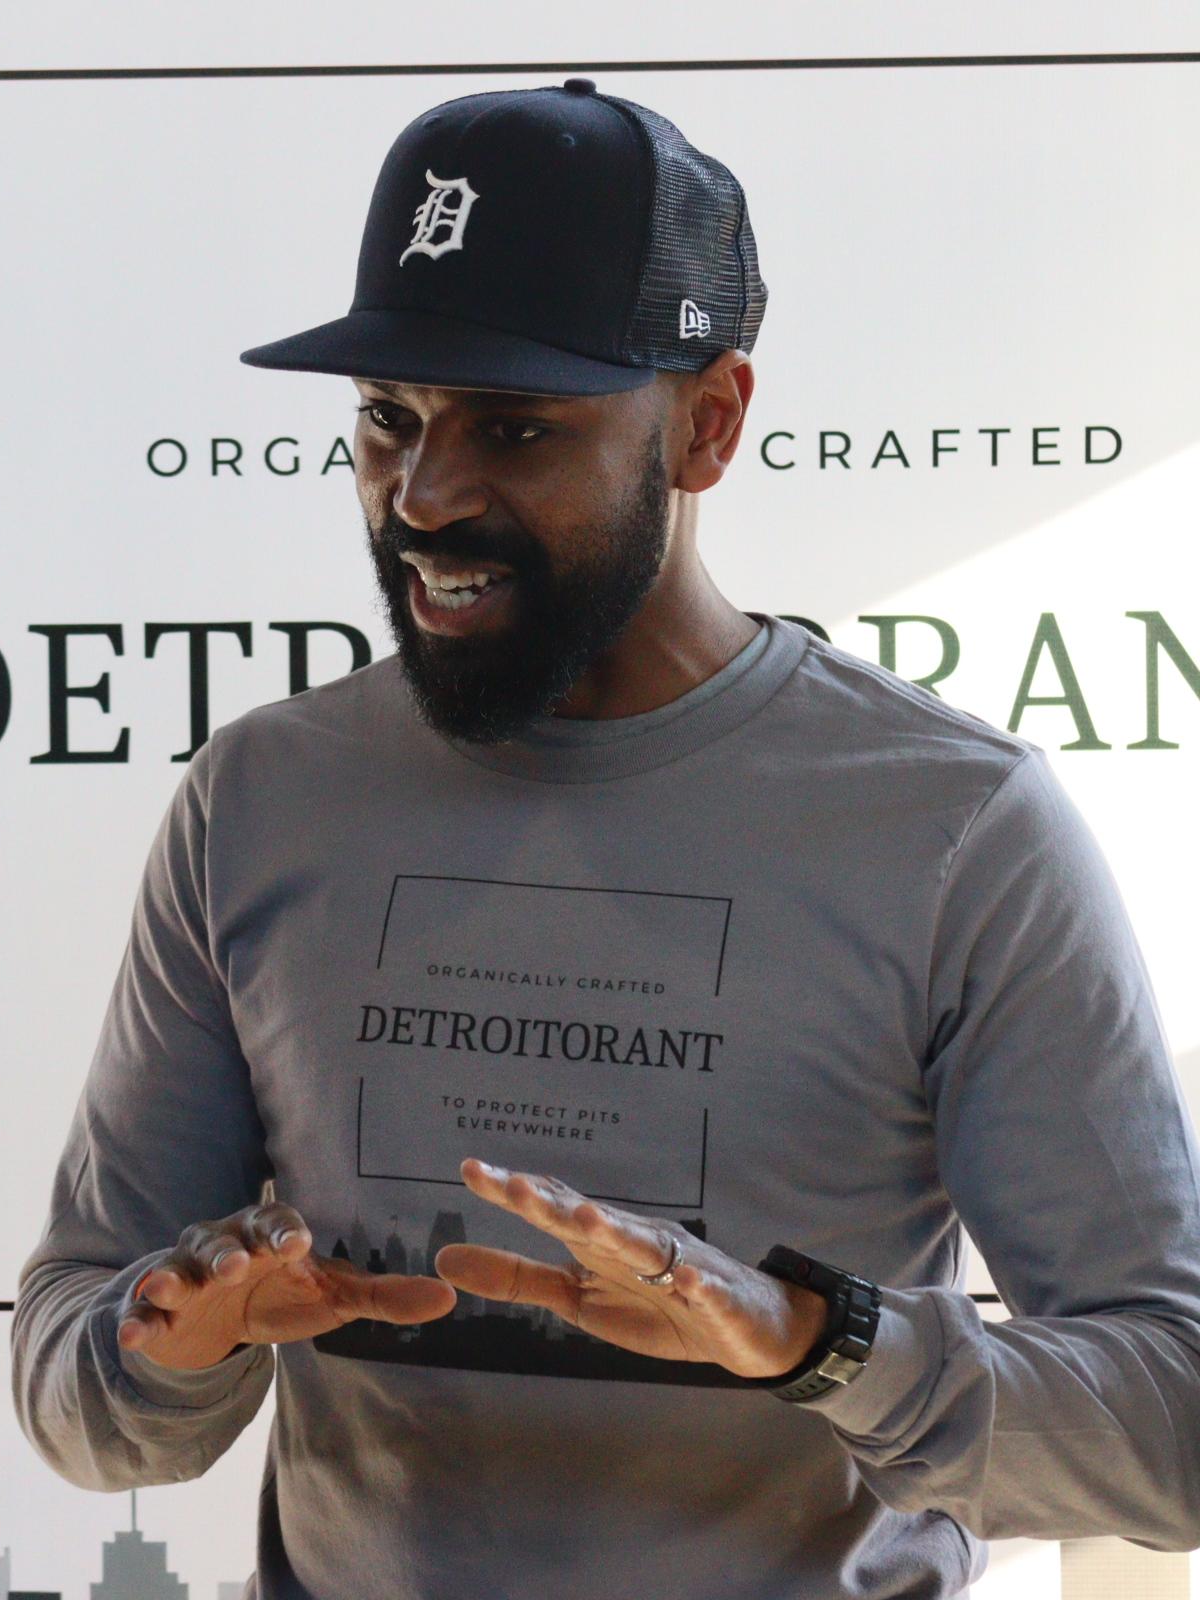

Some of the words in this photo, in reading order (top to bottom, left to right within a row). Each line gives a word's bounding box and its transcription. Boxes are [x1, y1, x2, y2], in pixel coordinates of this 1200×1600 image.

[399, 168, 480, 268] D
[760, 425, 1123, 471] CRAFTED
[427, 964, 567, 988] ORGANICALLY
[576, 977, 666, 995] CRAFTED
[356, 1005, 723, 1073] DETROITORANT
[442, 1096, 465, 1109] TO
[477, 1099, 568, 1119] PROTECT
[578, 1110, 621, 1124] PITS
[457, 1116, 594, 1141] EVERYWHERE
